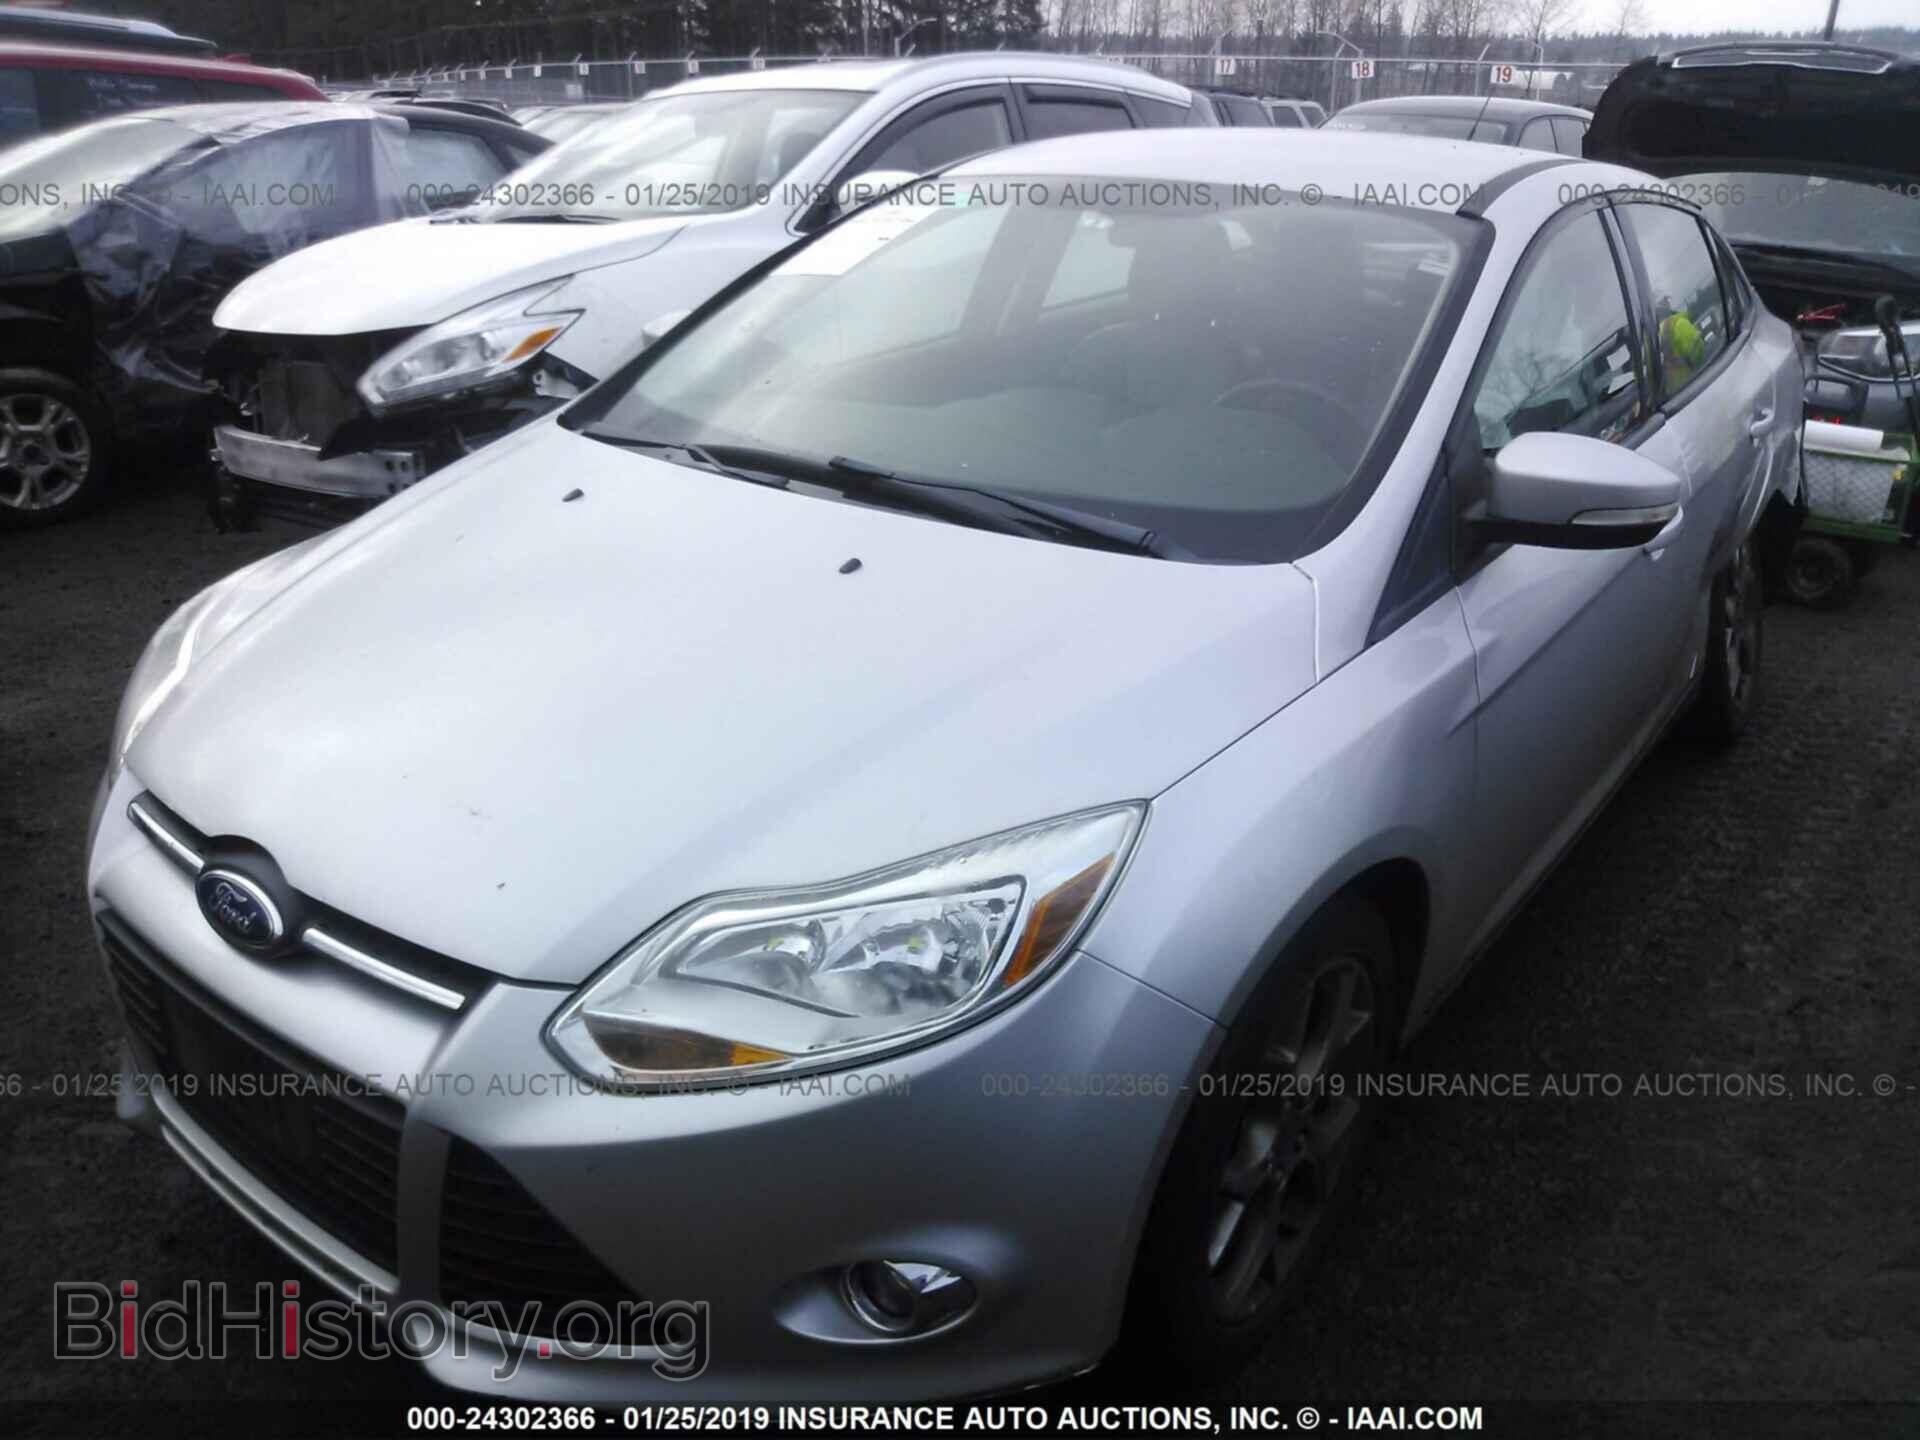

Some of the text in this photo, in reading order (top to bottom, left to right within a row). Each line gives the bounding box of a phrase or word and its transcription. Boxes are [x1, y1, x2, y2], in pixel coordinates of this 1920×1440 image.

[1220, 59, 1231, 73] 17
[1356, 61, 1370, 76] 18
[1496, 66, 1512, 82] 19
